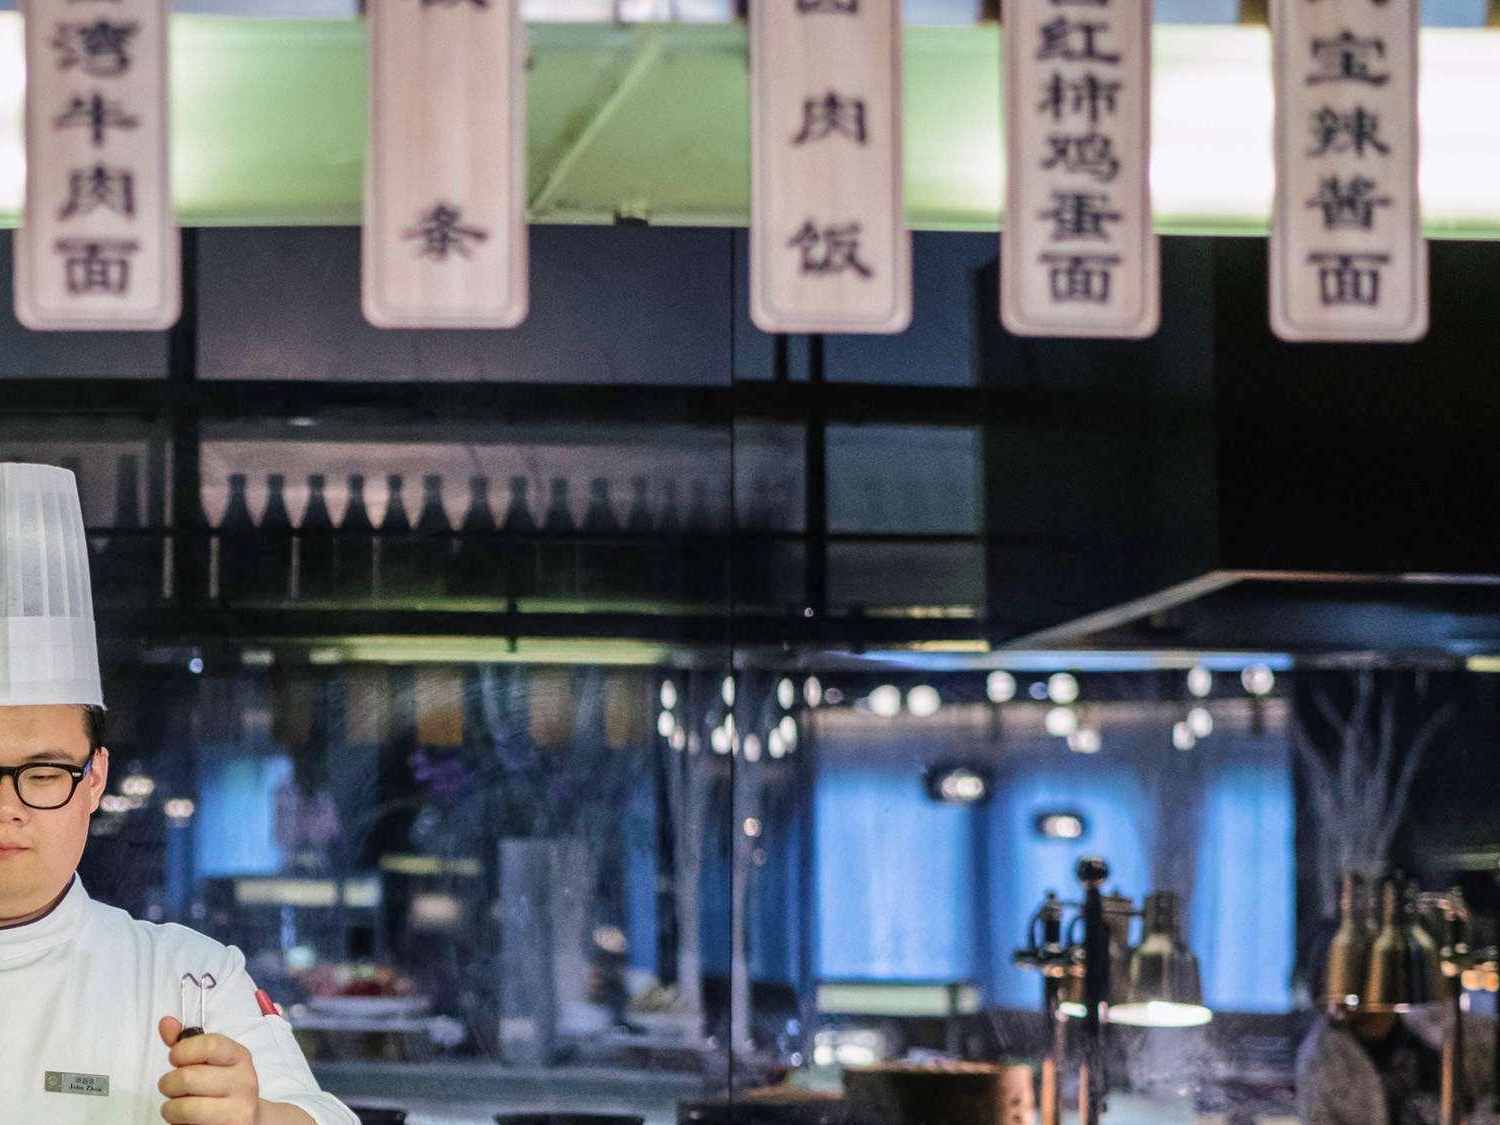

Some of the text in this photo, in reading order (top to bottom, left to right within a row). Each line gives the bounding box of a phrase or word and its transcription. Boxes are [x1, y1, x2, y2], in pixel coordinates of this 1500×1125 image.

[52, 0, 138, 292] 湾牛肉面
[789, 0, 874, 279] 肉饭
[1037, 0, 1122, 303] 红柿鸡蛋面
[1305, 0, 1390, 307] 宝辣酱面
